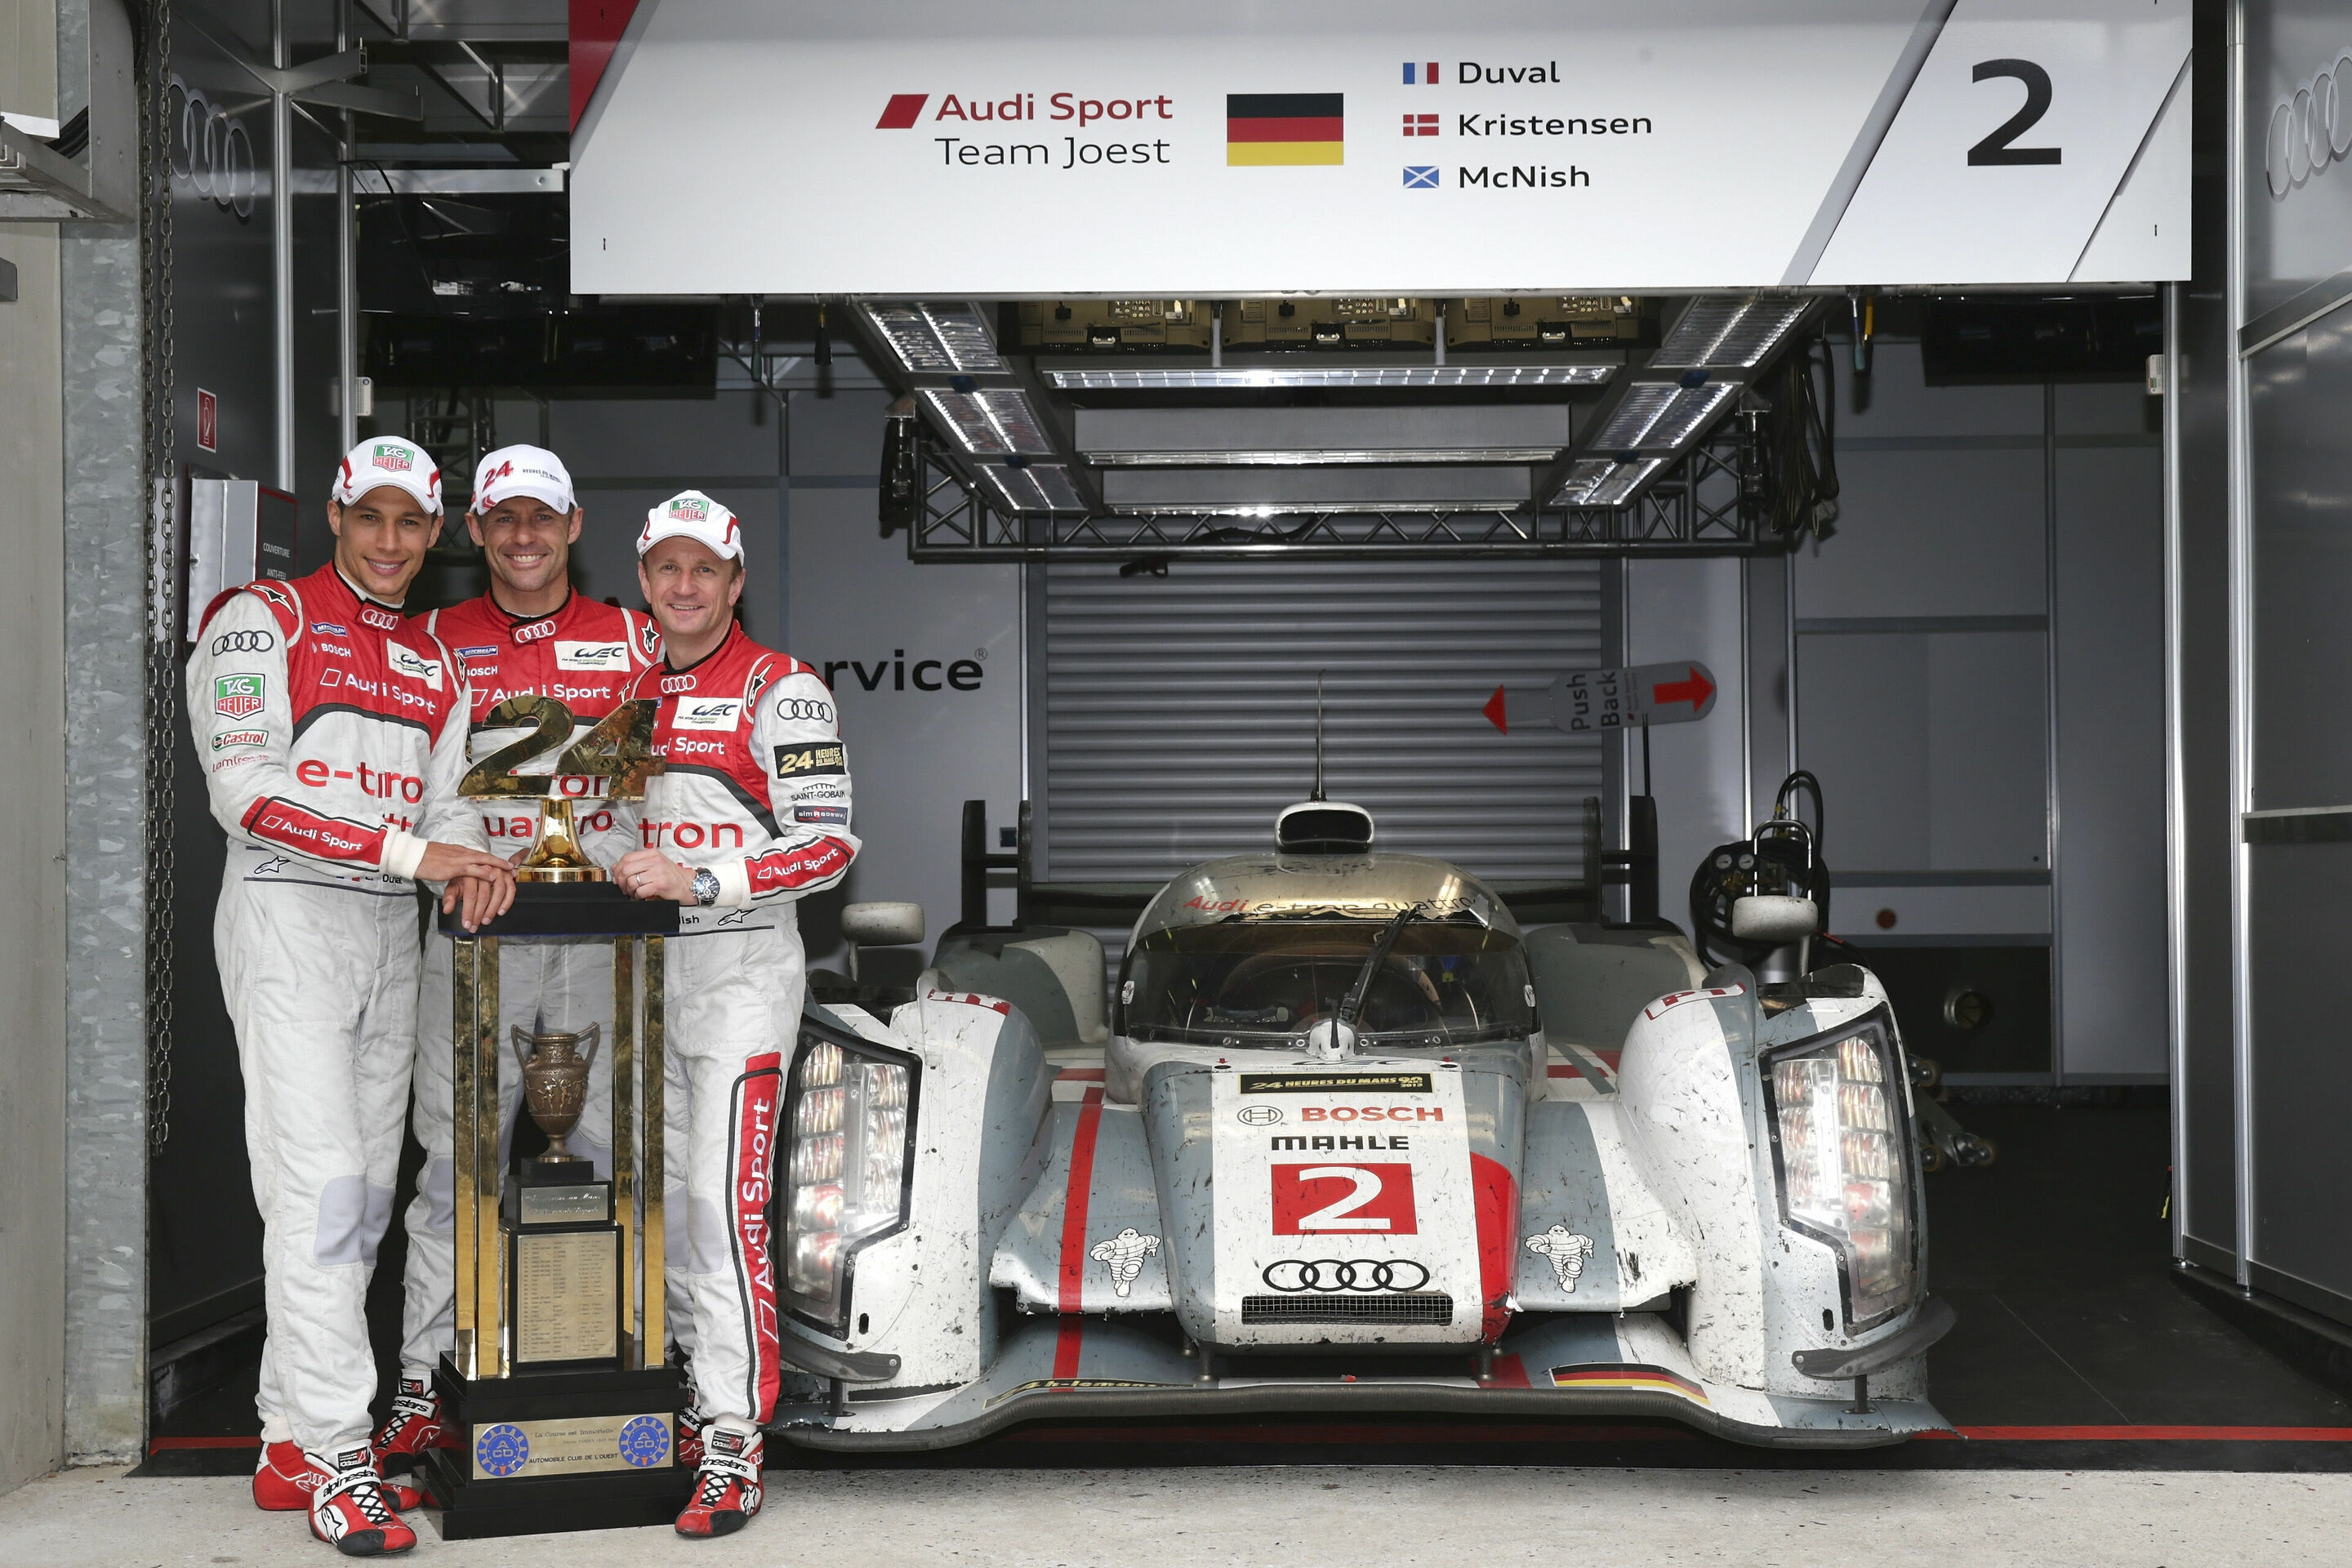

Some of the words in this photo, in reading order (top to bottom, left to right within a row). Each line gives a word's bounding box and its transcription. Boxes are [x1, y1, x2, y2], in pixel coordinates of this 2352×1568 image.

[1459, 60, 1561, 85] Duval
[935, 93, 1035, 121] Audi
[1049, 92, 1174, 127] Sport
[1967, 58, 2062, 167] 2
[1459, 111, 1652, 137] Kristensen
[934, 137, 1049, 165] Team
[1062, 136, 1170, 169] Joest
[1459, 164, 1590, 189] McNish
[382, 447, 407, 458] TAG
[376, 457, 410, 470] HEUER
[482, 460, 514, 492] 24
[678, 500, 702, 509] TAG
[671, 509, 704, 520] HEUER
[263, 542, 291, 559] COUVERTURE
[321, 643, 351, 657] BOSCH
[223, 678, 255, 696] TAG
[553, 684, 611, 702] Sport
[219, 697, 260, 715] HEUER
[391, 685, 436, 715] Spot
[1566, 672, 1591, 731] Push
[1596, 670, 1621, 727] Back
[692, 703, 738, 716] WEC
[223, 732, 265, 746] Castrol
[675, 737, 725, 755] Sport
[780, 750, 814, 774] 24
[791, 790, 846, 801] SAINT-GOBAIN
[282, 822, 317, 840] Audi
[321, 831, 363, 850] Sport
[774, 862, 801, 876] Audi
[804, 849, 839, 871] Sport
[1183, 895, 1250, 913] Audi
[1249, 1081, 1283, 1090] 24
[1285, 1079, 1334, 1088] HEURES
[1301, 1107, 1444, 1122] BOSCH
[742, 1098, 770, 1202] Sport
[1271, 1135, 1409, 1152] MAHLE
[1298, 1166, 1391, 1230] 2
[323, 1469, 377, 1497] alpinestar
